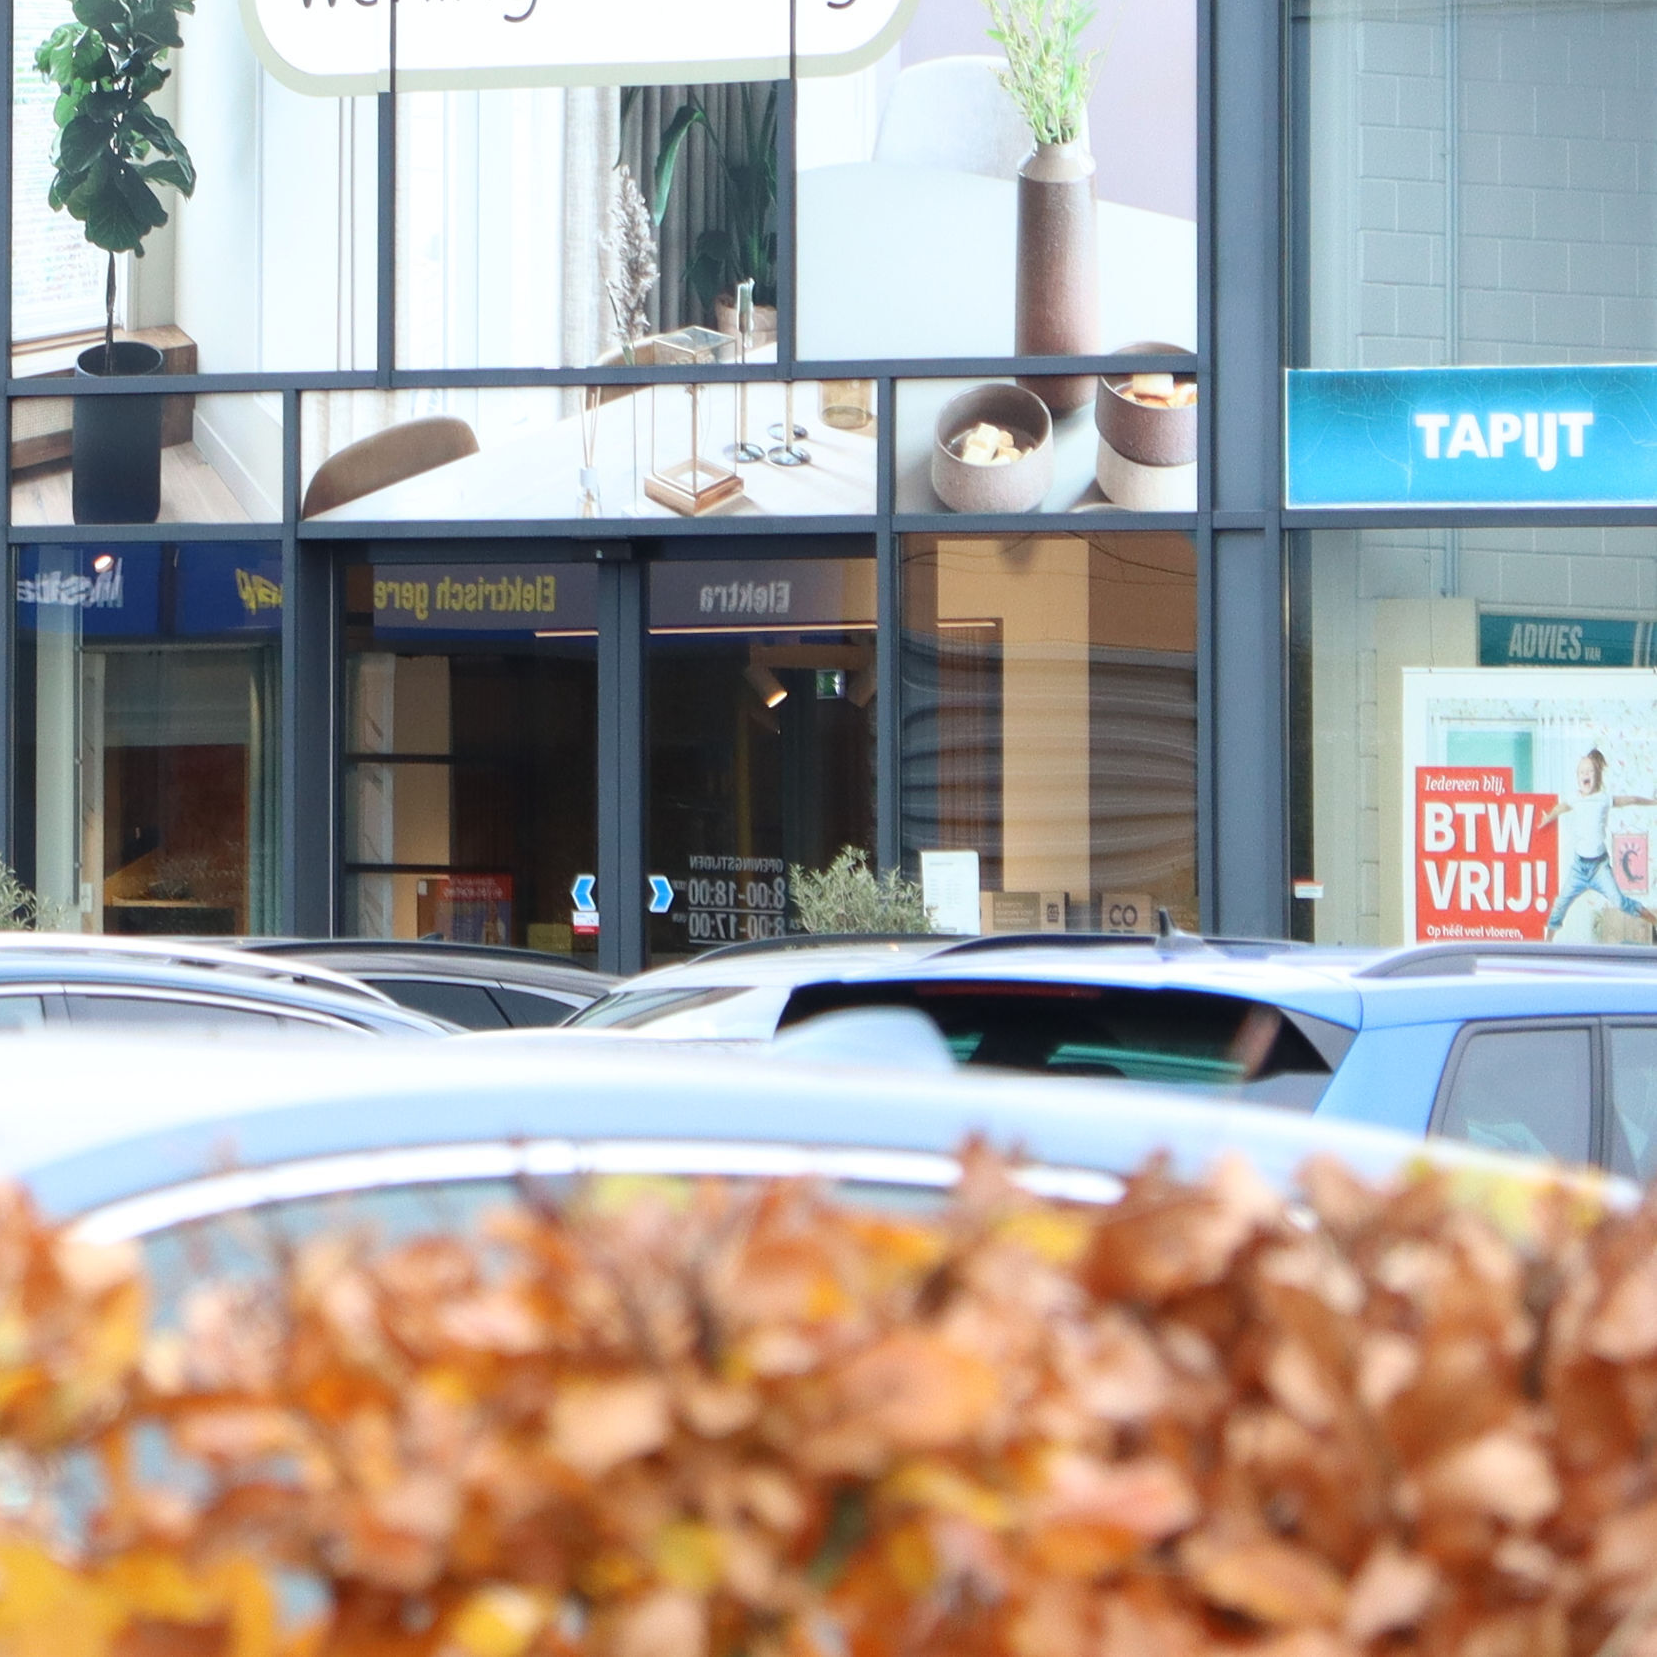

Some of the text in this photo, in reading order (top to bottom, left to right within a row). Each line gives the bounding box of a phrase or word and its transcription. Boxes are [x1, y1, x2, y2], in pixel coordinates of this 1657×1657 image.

[1415, 412, 1594, 472] TAPIJT
[1508, 622, 1585, 661] ADVIES
[1425, 774, 1506, 796] Iedereen blij,
[1423, 801, 1535, 854] BTW
[1423, 859, 1549, 913] VRIJ!
[1426, 923, 1524, 940] Op héél veel vloeren,
